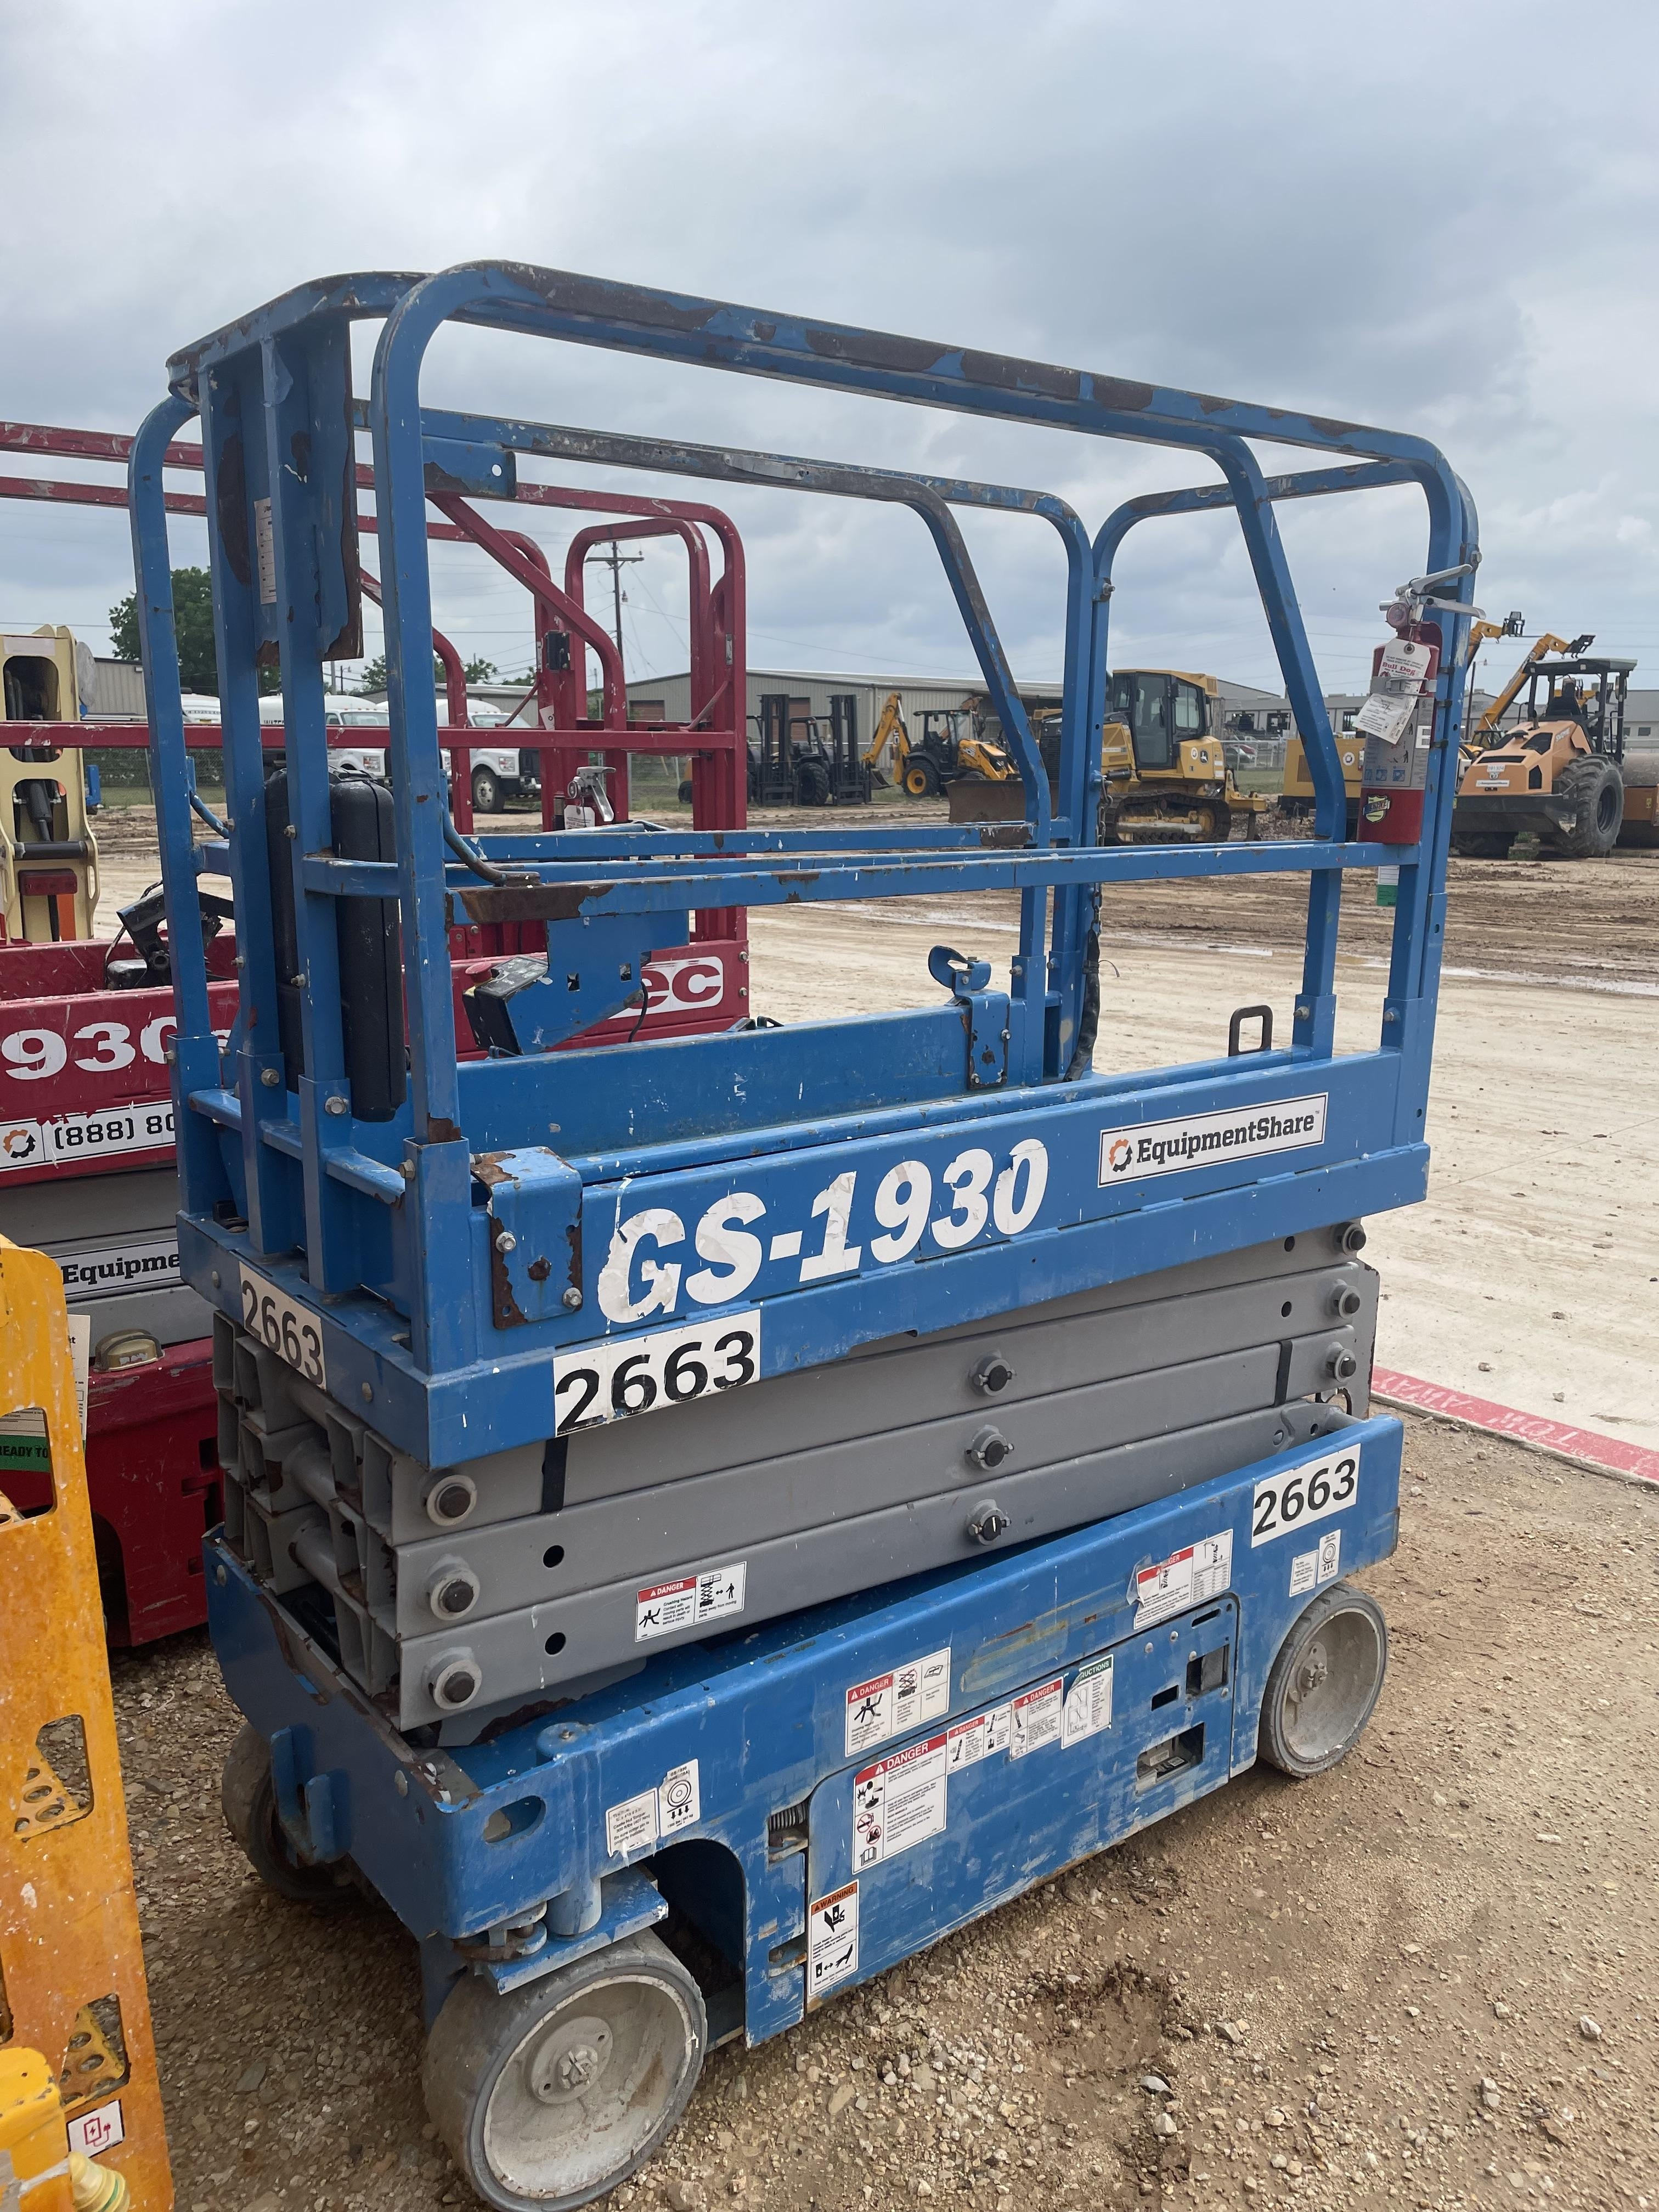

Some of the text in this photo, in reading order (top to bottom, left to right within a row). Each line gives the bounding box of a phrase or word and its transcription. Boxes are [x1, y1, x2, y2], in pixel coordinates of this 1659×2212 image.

[1382, 661, 1397, 670] Bull
[1400, 666, 1416, 677] Dog
[629, 964, 721, 1009] ec
[54, 1118, 135, 1150] (888)
[597, 1138, 1049, 1324] GS-1930
[60, 1254, 180, 1285] Equipme
[241, 1279, 324, 1385] 2663
[555, 1330, 755, 1436] 2663
[1252, 1458, 1356, 1537] 2663
[657, 1582, 684, 1595] DANGER
[1080, 1660, 1110, 1680] RUCTIONS
[859, 1678, 889, 1696] DANGER
[1030, 1684, 1055, 1701] DANGER
[958, 1719, 979, 1733] DANGER
[886, 1742, 929, 1770] DANGER
[613, 1821, 625, 1830] Castle
[820, 1886, 854, 1908] WARNING
